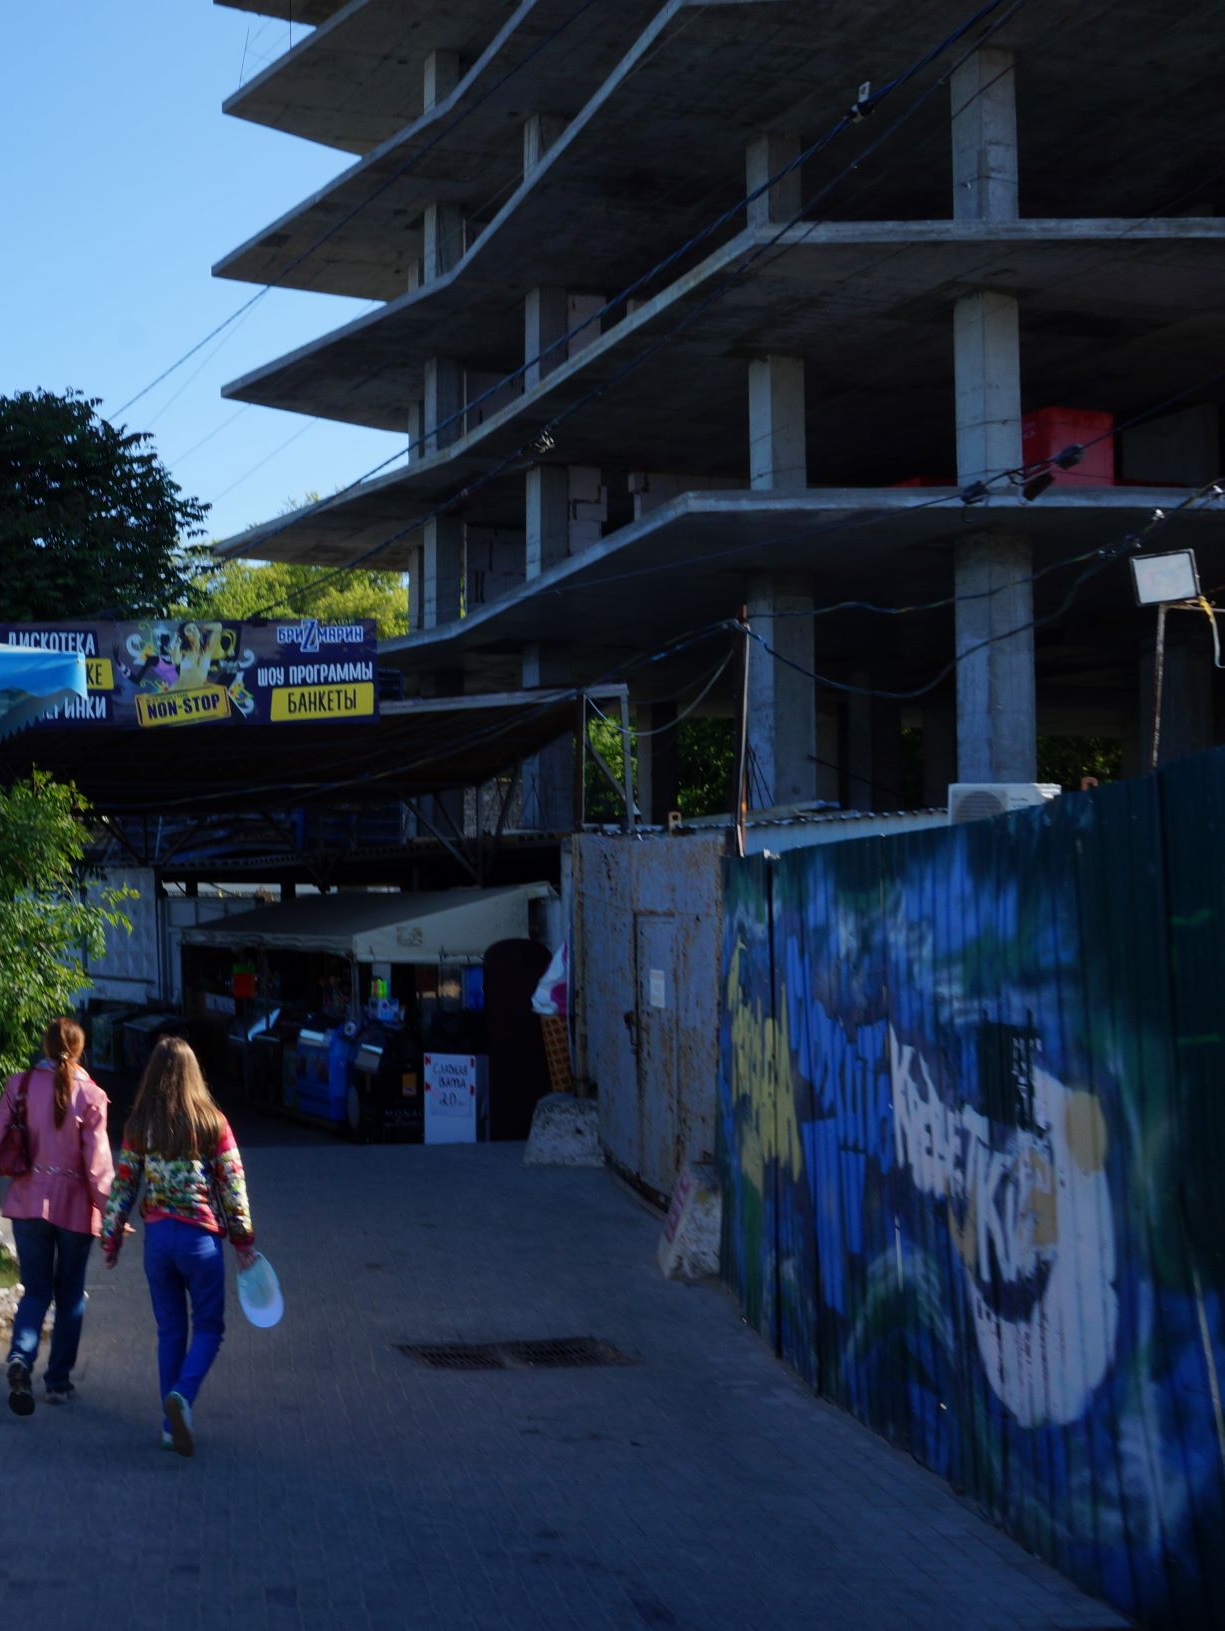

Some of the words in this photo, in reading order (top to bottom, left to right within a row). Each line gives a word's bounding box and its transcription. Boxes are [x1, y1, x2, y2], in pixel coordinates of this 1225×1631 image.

[8, 631, 96, 656] ДИСКОТЕКА
[257, 666, 285, 688] ШОУ
[289, 660, 374, 685] ПРОГРАММЫ
[146, 693, 220, 720] NON-STOP
[287, 688, 357, 714] БАНКЕТЫ
